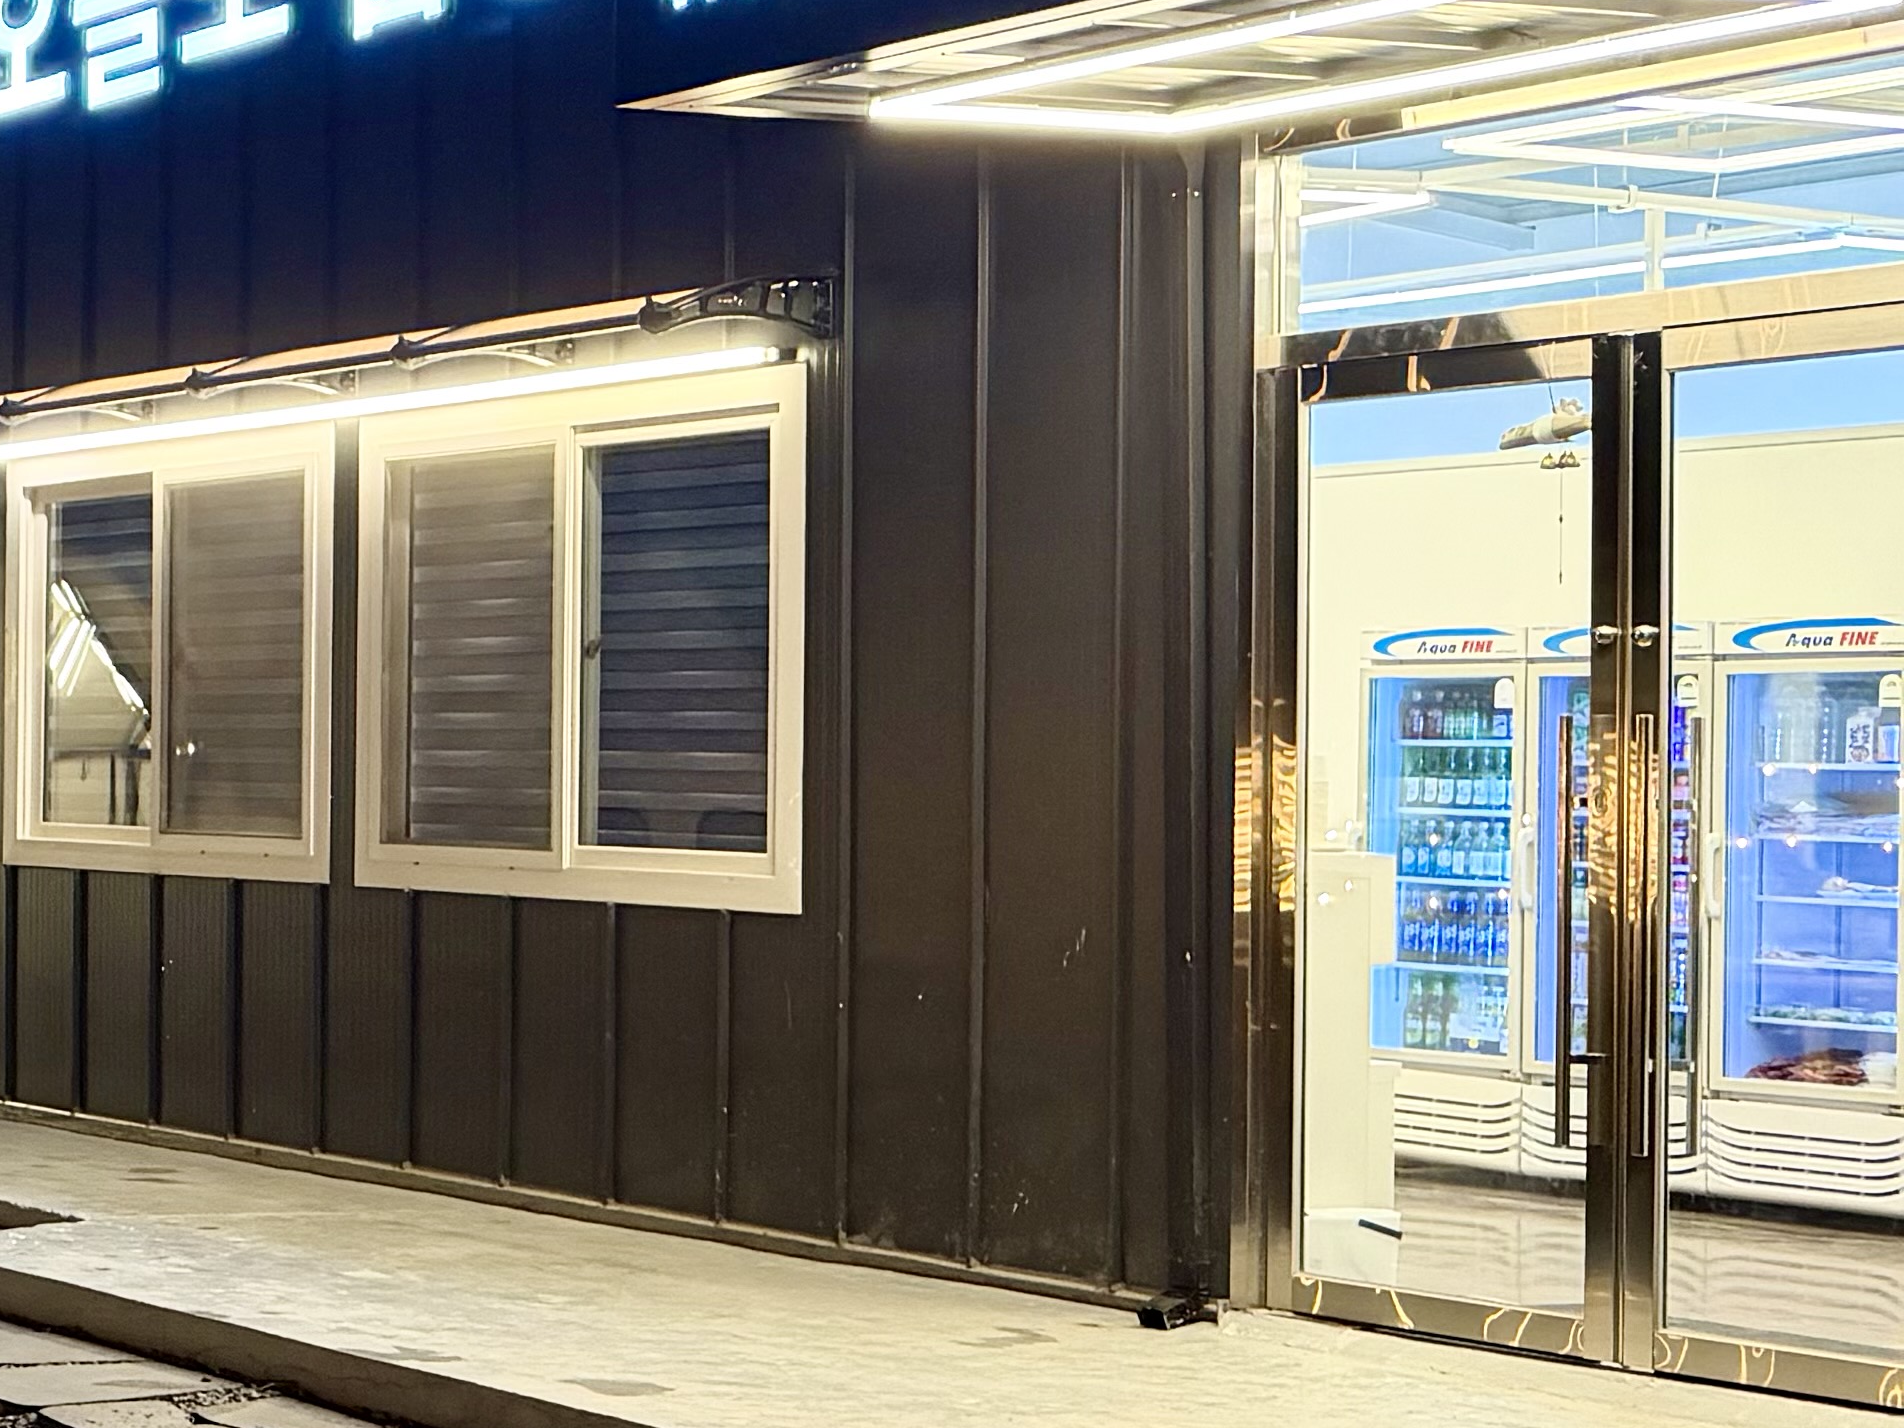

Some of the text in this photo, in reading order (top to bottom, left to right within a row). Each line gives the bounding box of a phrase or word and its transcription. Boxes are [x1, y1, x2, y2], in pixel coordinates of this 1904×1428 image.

[1461, 640, 1493, 654] FINE
[1785, 631, 1879, 648] Aqua FINE
